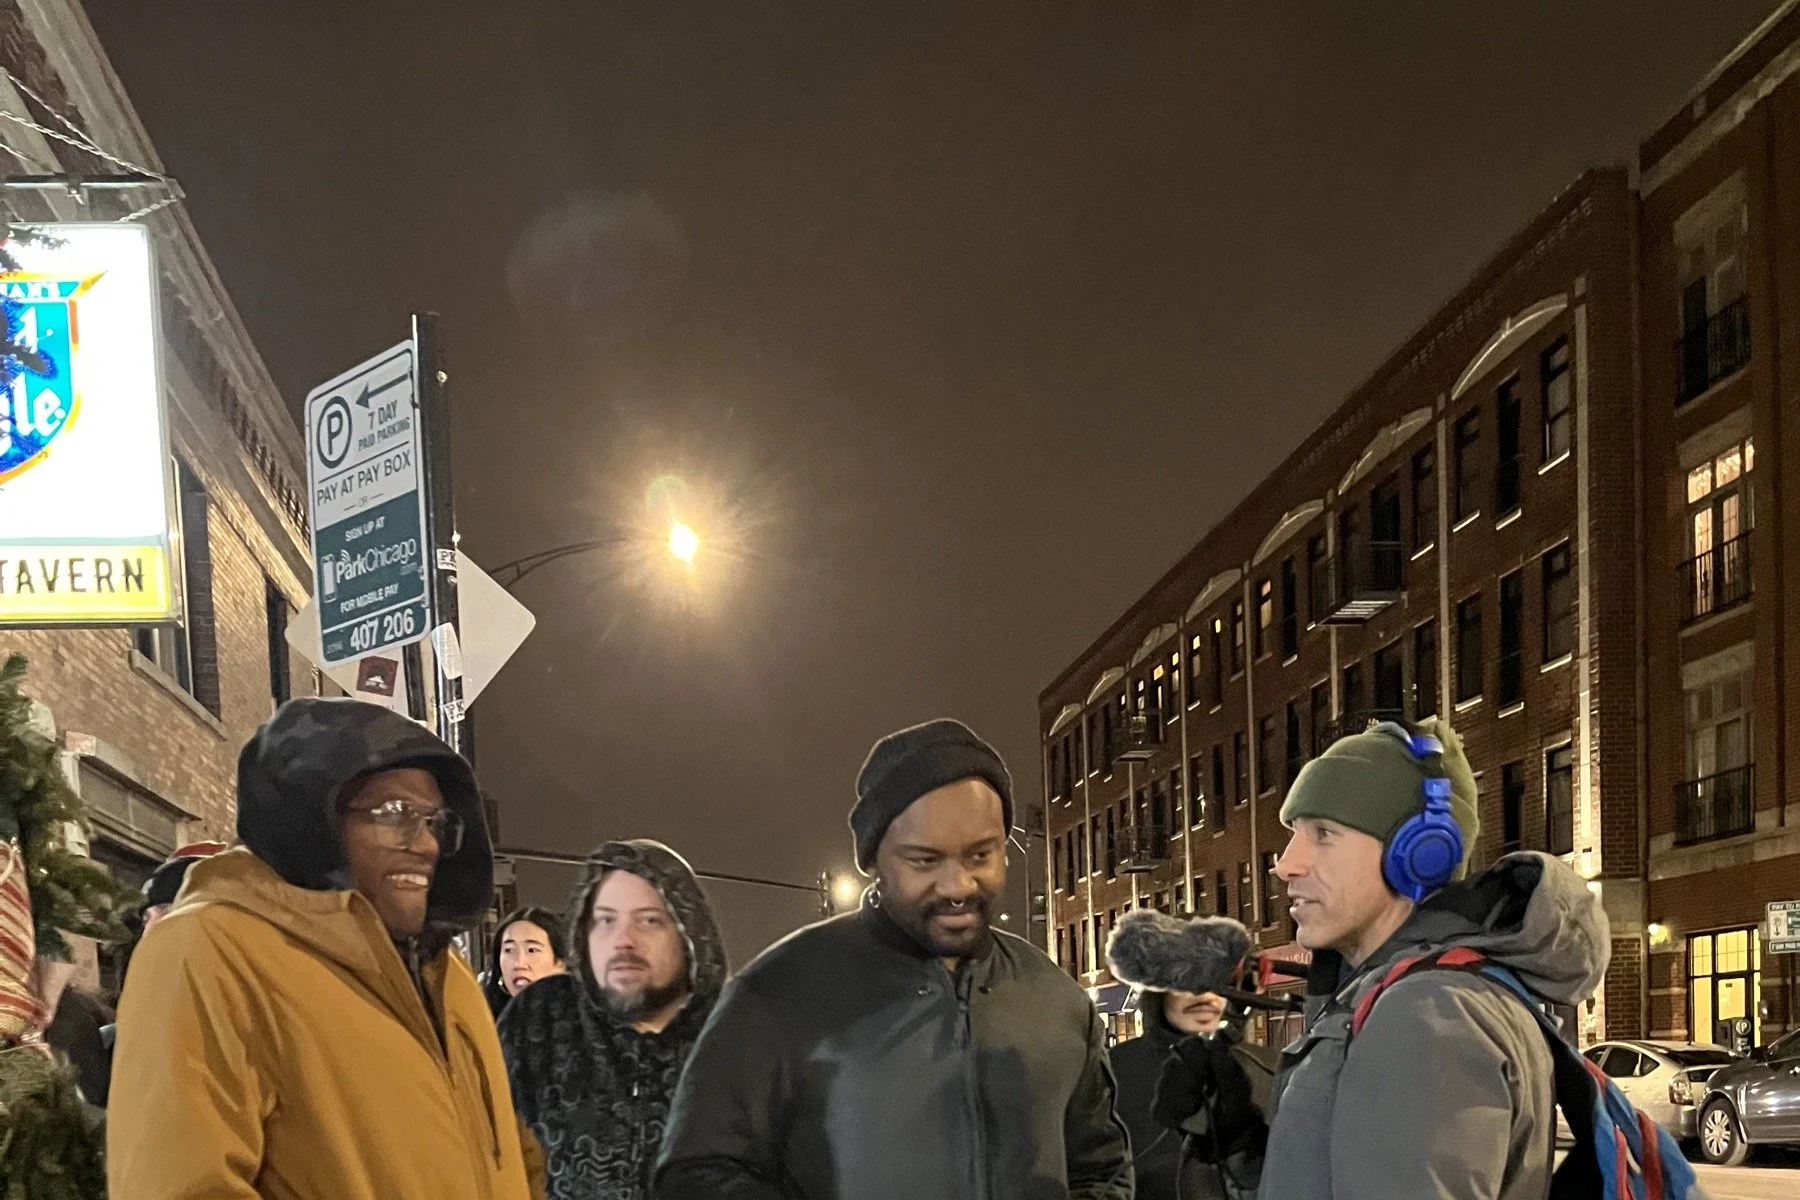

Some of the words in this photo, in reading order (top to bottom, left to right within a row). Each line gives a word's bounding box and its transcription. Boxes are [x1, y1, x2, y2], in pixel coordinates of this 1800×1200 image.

[368, 411, 375, 430] 7
[378, 399, 398, 424] DAY
[358, 433, 375, 452] PAID
[377, 417, 411, 443] PARKING
[316, 482, 338, 506] PAY
[340, 475, 354, 496] AT
[358, 463, 380, 488] PAY
[384, 449, 411, 477] BOX
[345, 526, 362, 541] SIGN
[363, 520, 375, 534] UP
[375, 516, 385, 531] AT
[336, 538, 417, 583] ParkChicago
[340, 599, 355, 613] FOR
[356, 588, 384, 607] MOBILE
[384, 582, 399, 598] PAY
[350, 617, 379, 651] 407
[383, 608, 415, 641] 206
